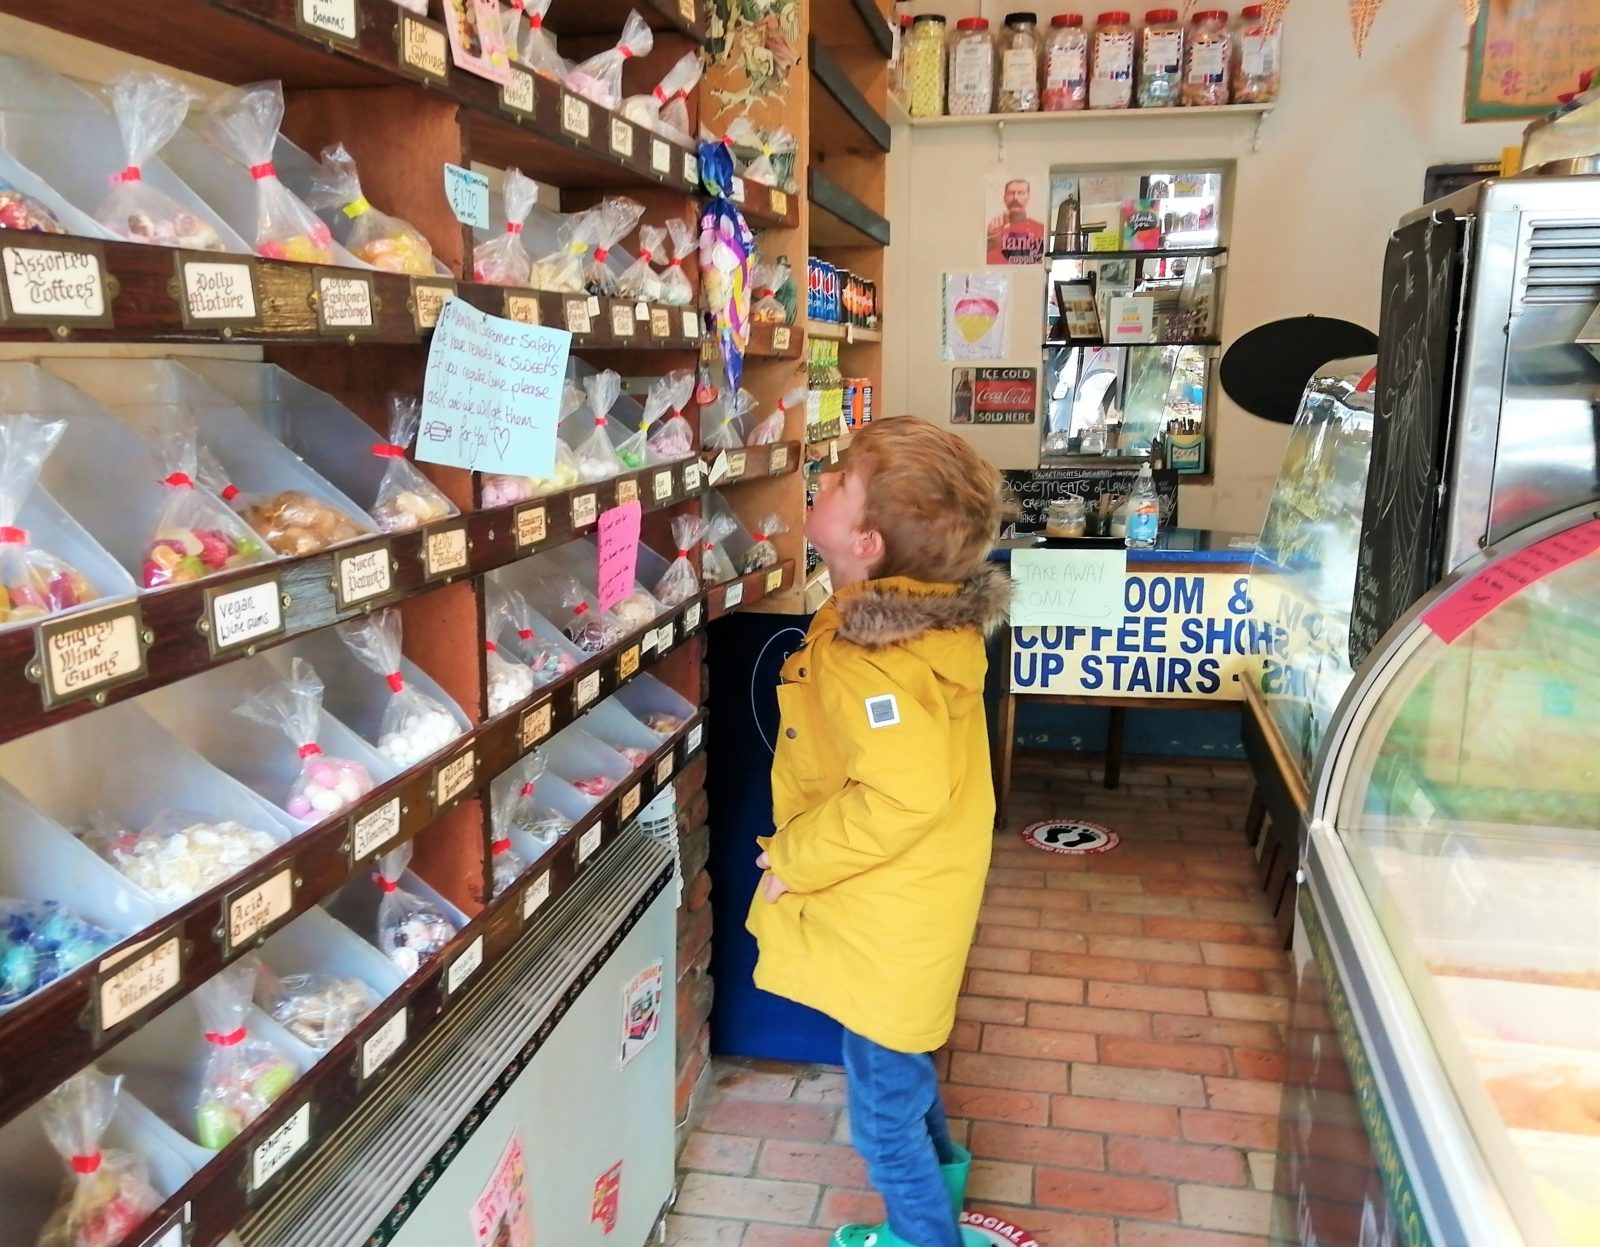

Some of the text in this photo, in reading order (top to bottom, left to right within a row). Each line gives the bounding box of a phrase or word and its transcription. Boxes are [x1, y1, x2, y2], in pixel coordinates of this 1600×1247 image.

[313, 5, 345, 30] Bananas
[25, 275, 96, 309] Toffees
[190, 291, 244, 312] Mixture
[982, 369, 1031, 379] ICE COLD
[979, 412, 1031, 422] SOLD HERE
[1020, 562, 1106, 582] TAKE AWAY
[1124, 576, 1254, 615] OOM &
[60, 642, 104, 672] Wine
[64, 651, 119, 688] Gums
[1014, 652, 1065, 688] UP
[1079, 655, 1221, 694] STAIRS
[233, 892, 264, 924] Acid
[960, 1211, 1024, 1242] SOCIAL
